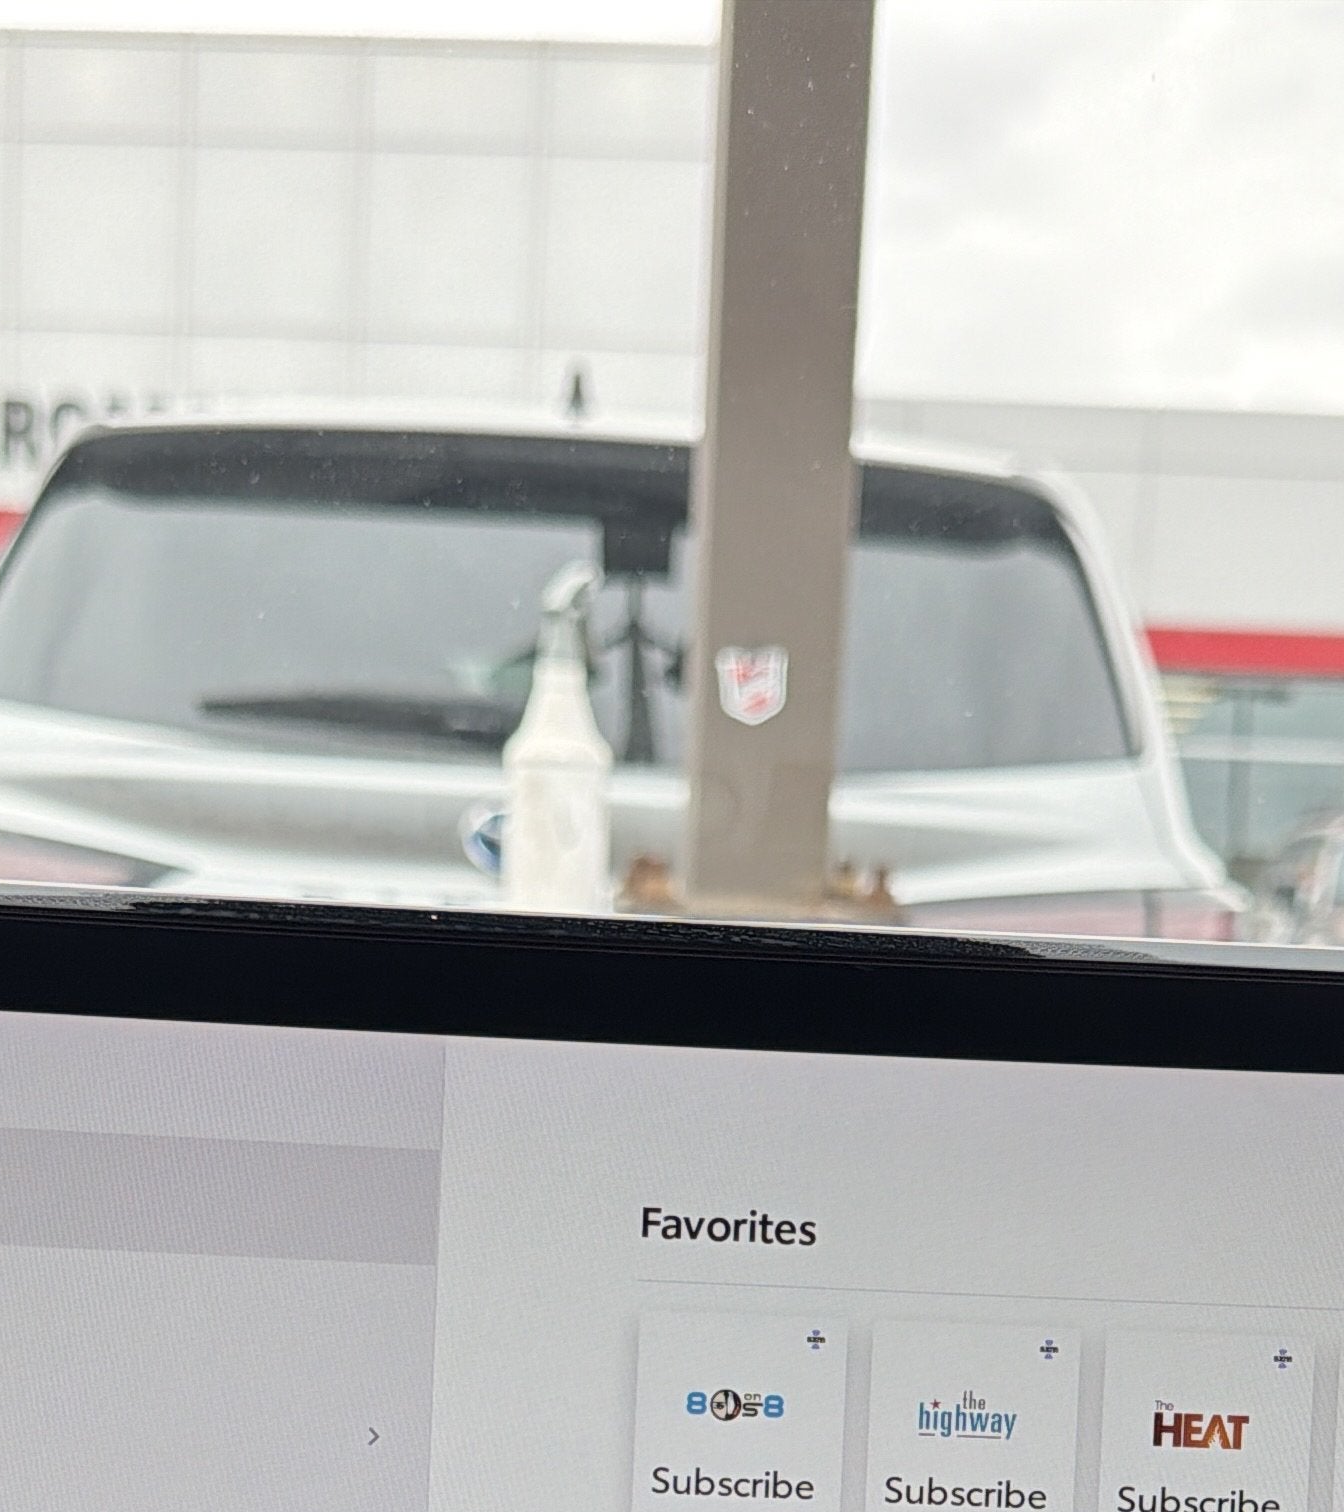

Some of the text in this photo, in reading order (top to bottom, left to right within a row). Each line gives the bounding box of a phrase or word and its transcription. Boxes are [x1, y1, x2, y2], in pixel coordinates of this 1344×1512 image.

[641, 1206, 816, 1246] Favorites
[918, 1389, 1018, 1441] the highway
[1152, 1400, 1250, 1451] The HEAT
[651, 1466, 814, 1500] Subscribe
[884, 1476, 1047, 1510] Subscribe
